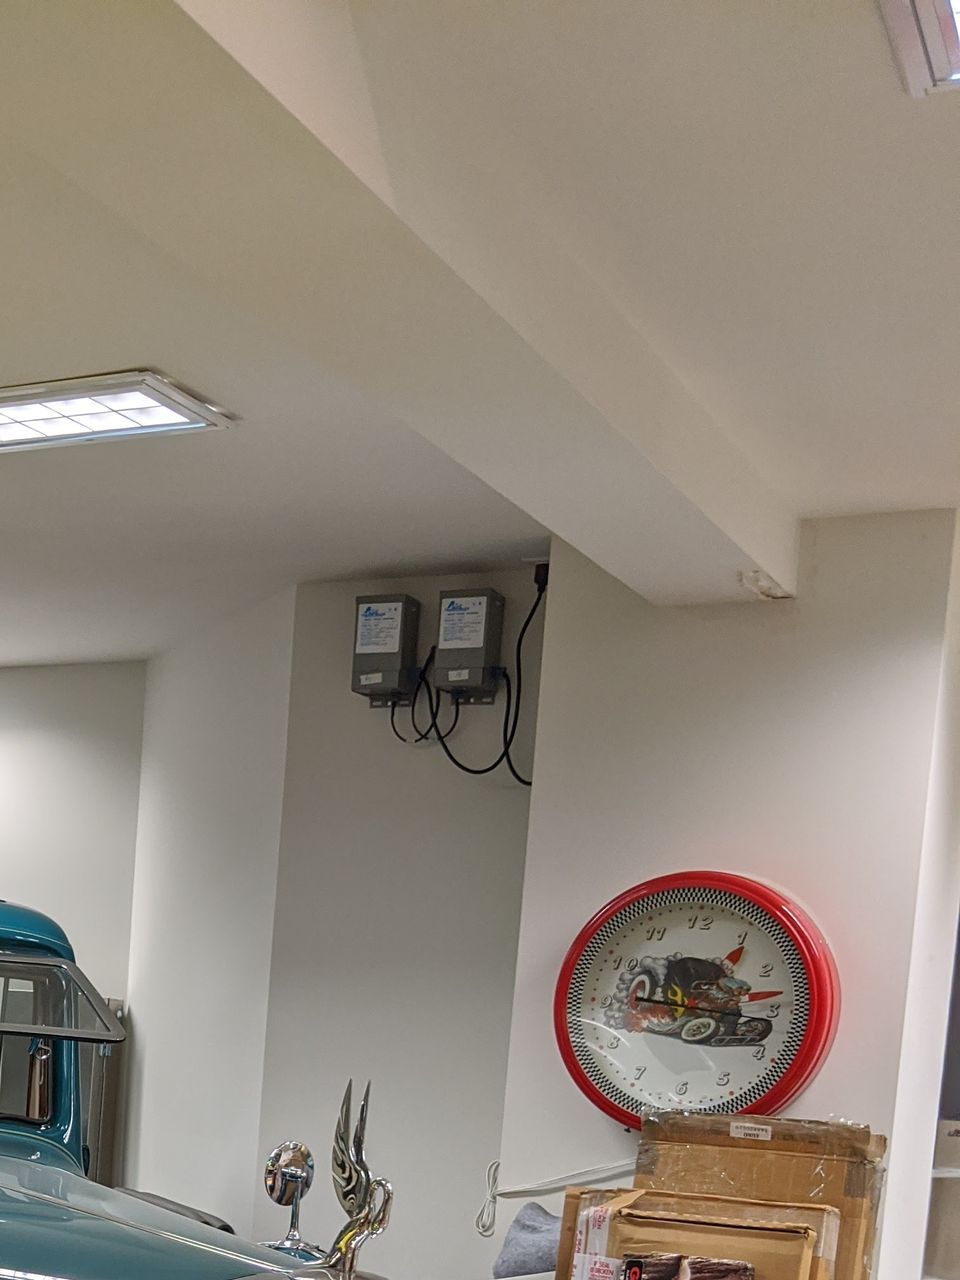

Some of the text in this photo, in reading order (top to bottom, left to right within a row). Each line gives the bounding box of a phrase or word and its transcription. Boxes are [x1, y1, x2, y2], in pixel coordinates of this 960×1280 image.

[688, 915, 714, 931] 12
[646, 926, 666, 941] 11
[738, 931, 748, 945] 1
[612, 955, 639, 971] 10
[759, 962, 774, 977] 2
[600, 995, 614, 1009] 9
[766, 1004, 780, 1018] 3
[607, 1036, 621, 1050] 8
[752, 1045, 766, 1060] 4
[634, 1066, 647, 1080] 7
[716, 1072, 730, 1086] 5
[675, 1081, 689, 1096] 6
